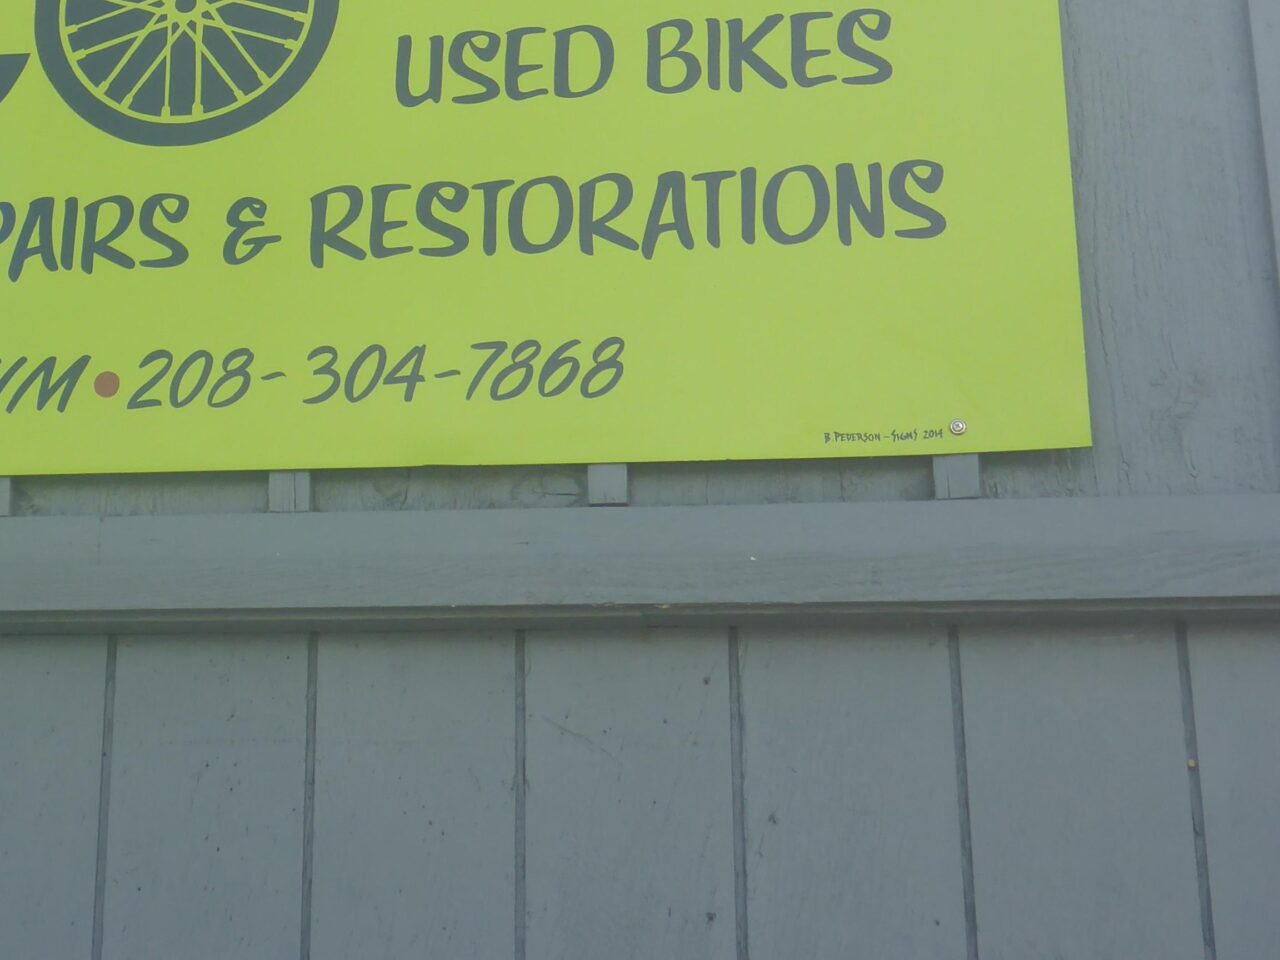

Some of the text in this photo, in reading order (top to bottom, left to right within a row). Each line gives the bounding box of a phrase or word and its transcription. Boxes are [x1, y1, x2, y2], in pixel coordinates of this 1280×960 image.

[396, 9, 892, 107] USED BIKES
[223, 197, 281, 265] &
[310, 160, 946, 268] RESTORATIONS
[922, 428, 943, 440] 2014
